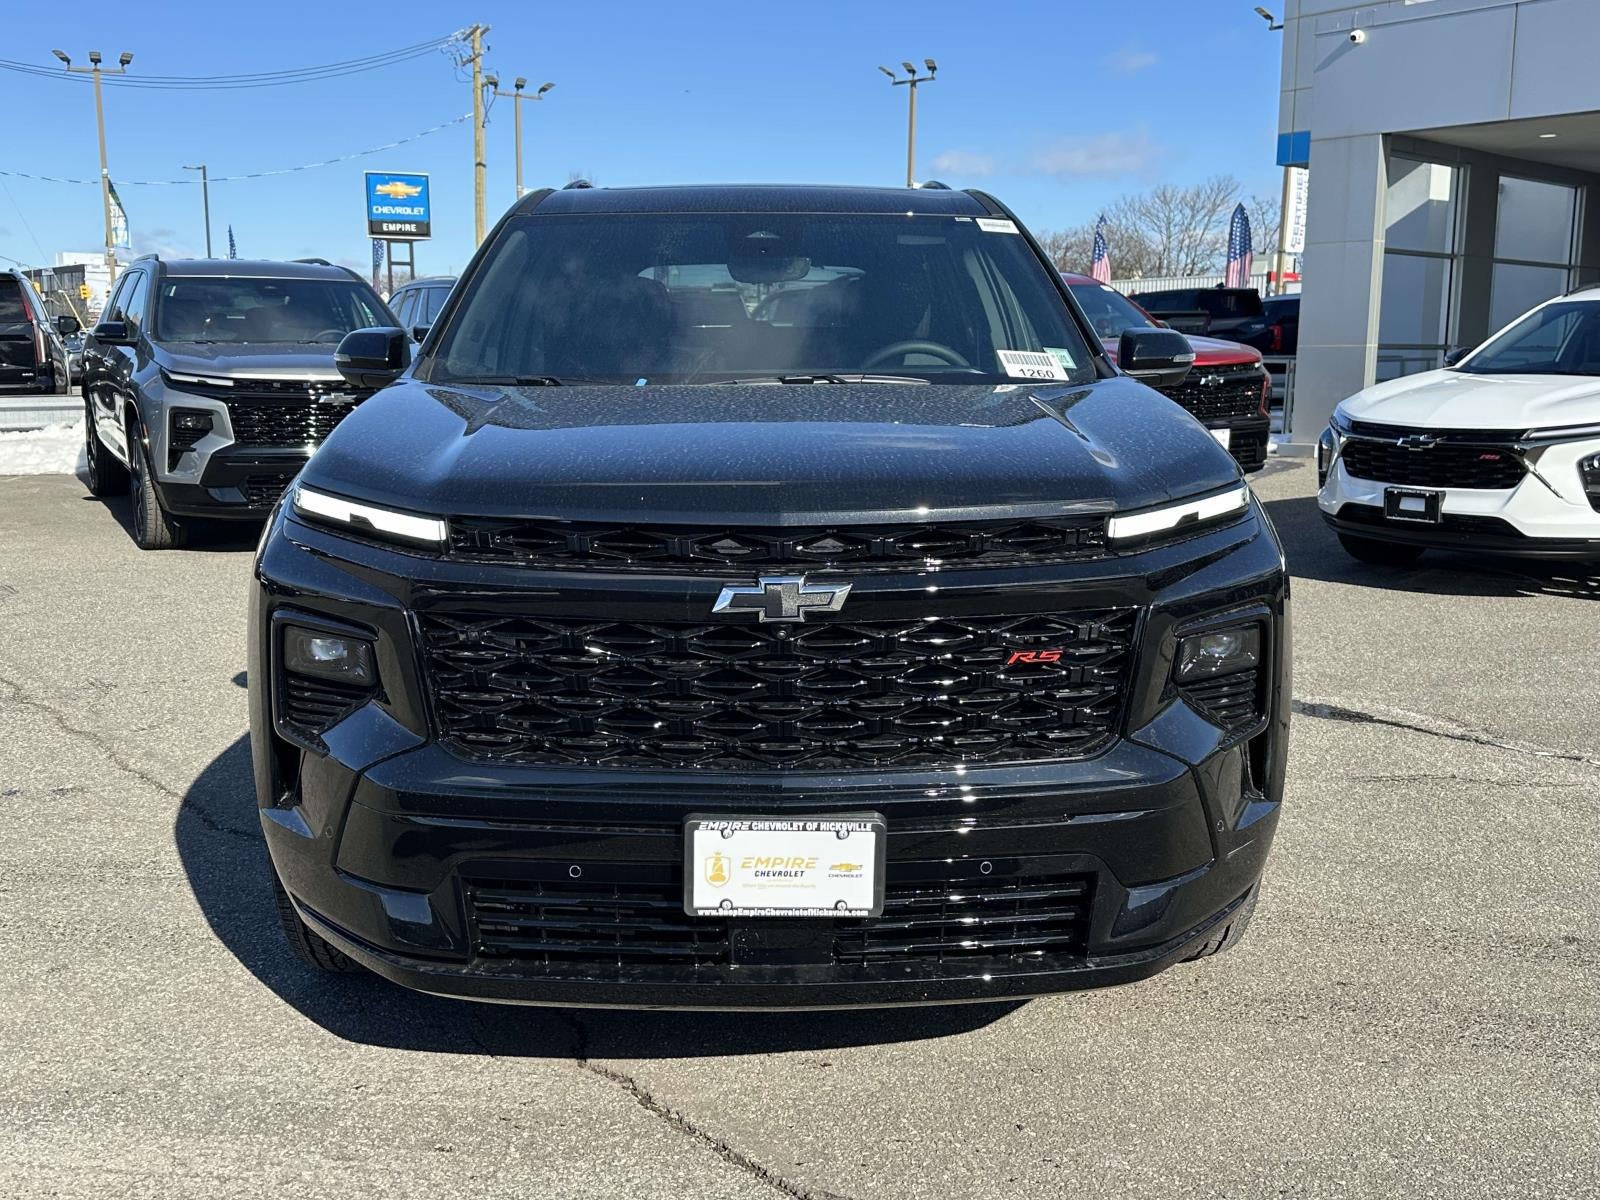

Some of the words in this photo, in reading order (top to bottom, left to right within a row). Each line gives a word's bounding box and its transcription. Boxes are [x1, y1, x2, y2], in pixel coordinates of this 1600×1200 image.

[372, 205, 425, 215] CHEVROLET
[382, 223, 417, 232] EMPIRE
[1019, 368, 1055, 379] 1260
[1007, 650, 1063, 664] RS
[698, 821, 752, 831] EMPIRE
[751, 822, 804, 831] CHEVROLET
[805, 822, 819, 831] OF
[820, 822, 872, 832] HICKSVILLE
[741, 857, 819, 869] EMPIRE
[754, 870, 805, 878] CHEVROLET
